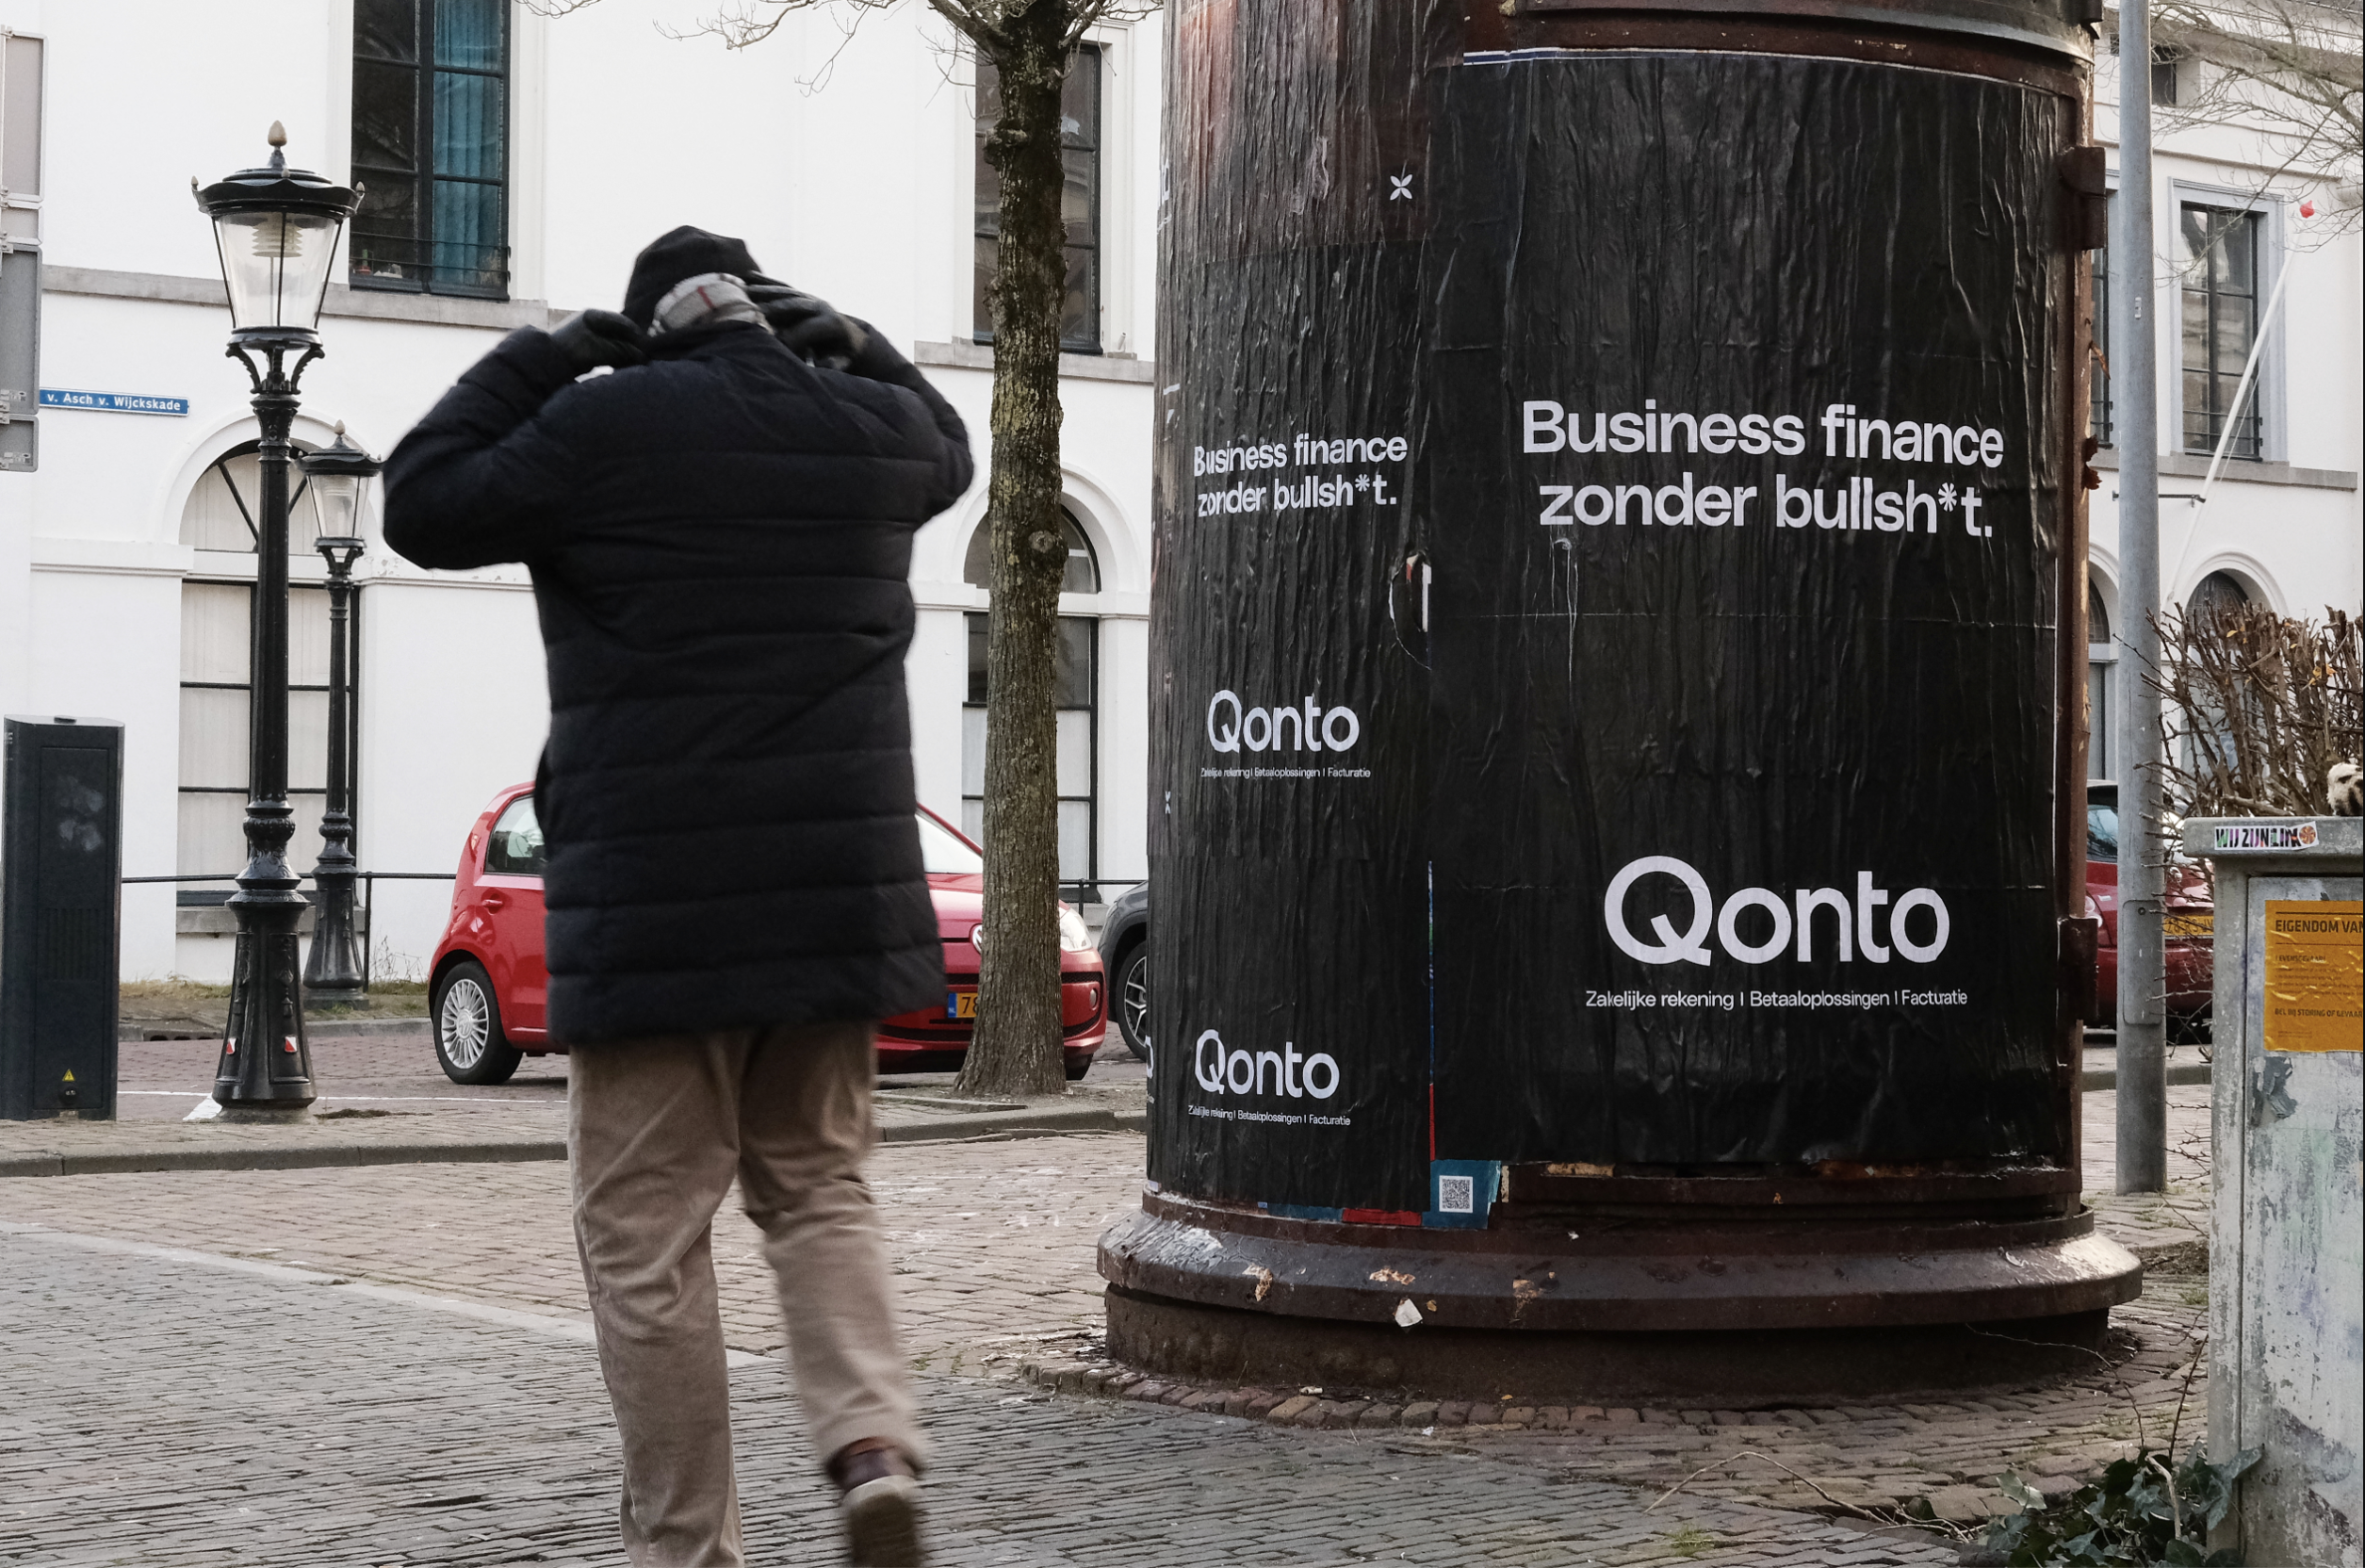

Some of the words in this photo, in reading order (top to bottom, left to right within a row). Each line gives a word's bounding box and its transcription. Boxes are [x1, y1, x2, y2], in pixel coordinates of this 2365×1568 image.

[47, 393, 58, 402] v.
[63, 393, 93, 404] Asch
[98, 397, 109, 406] v.
[114, 396, 181, 410] Wijckskade
[1523, 399, 1805, 456] Business
[1821, 403, 2004, 468] finance
[1193, 440, 1288, 477] Business
[1294, 433, 1408, 466] finance
[1198, 482, 1266, 517] zonder
[1540, 471, 1757, 527] zonder
[1207, 689, 1360, 753] Qonto
[1328, 767, 1371, 778] Facturatie
[1604, 855, 1950, 967] Qonto
[2275, 920, 2339, 933] EIGENDOM
[1586, 990, 1656, 1011] Zakelijke
[1660, 990, 1735, 1011] rekening
[1750, 989, 1890, 1010] Betaaloplossingen
[1901, 989, 1968, 1005] Facturatie
[1195, 1029, 1340, 1099] Qonto
[1310, 1114, 1351, 1126] Facturatie
